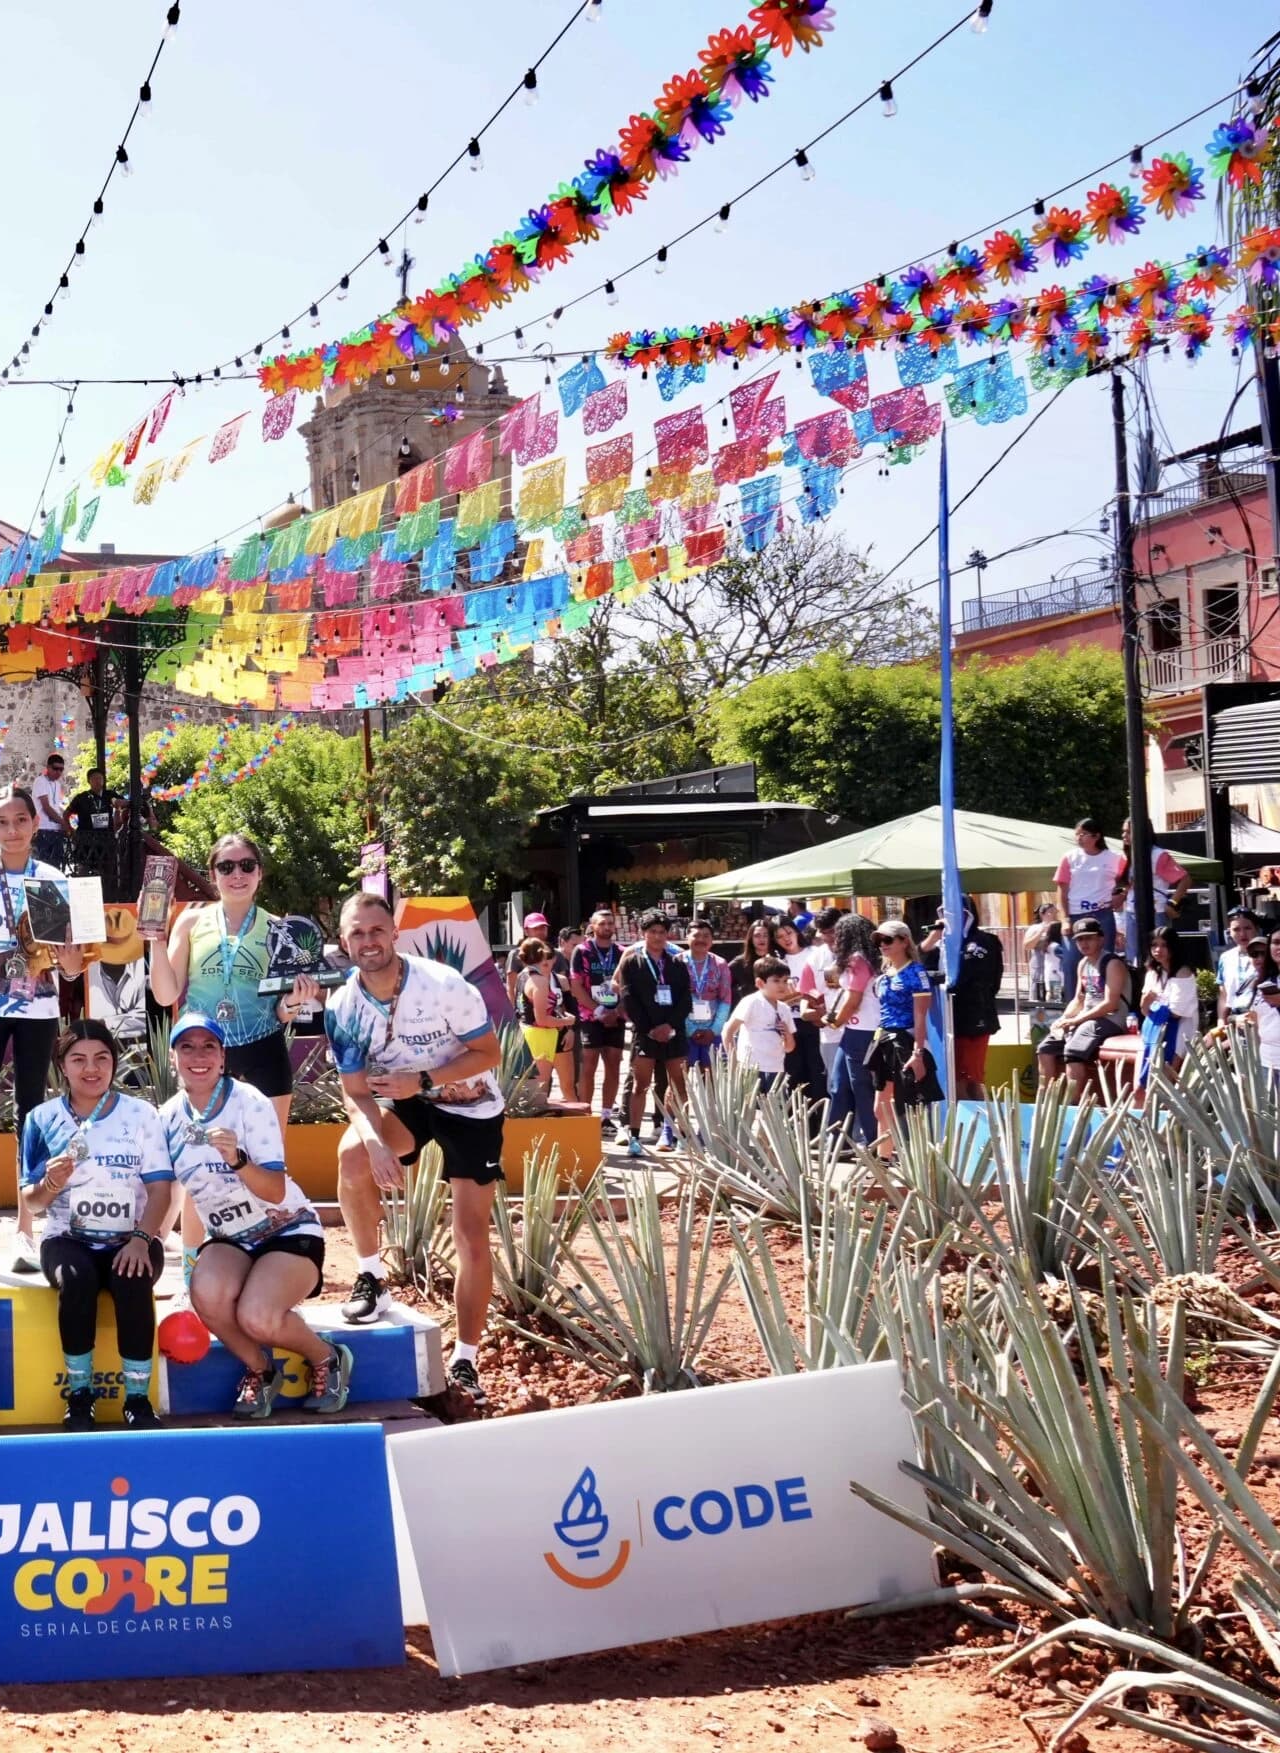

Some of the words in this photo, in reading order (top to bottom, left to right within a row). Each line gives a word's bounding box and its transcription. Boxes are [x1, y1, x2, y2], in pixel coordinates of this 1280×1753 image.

[94, 1154, 143, 1169] TEQUIL
[77, 1201, 130, 1218] 0001
[208, 1200, 252, 1227] 0577
[653, 1476, 813, 1541] CODE
[14, 1554, 229, 1615] CORRE
[20, 1621, 92, 1637] SERIAL
[97, 1620, 120, 1635] DE
[124, 1615, 233, 1633] CARRERAS
